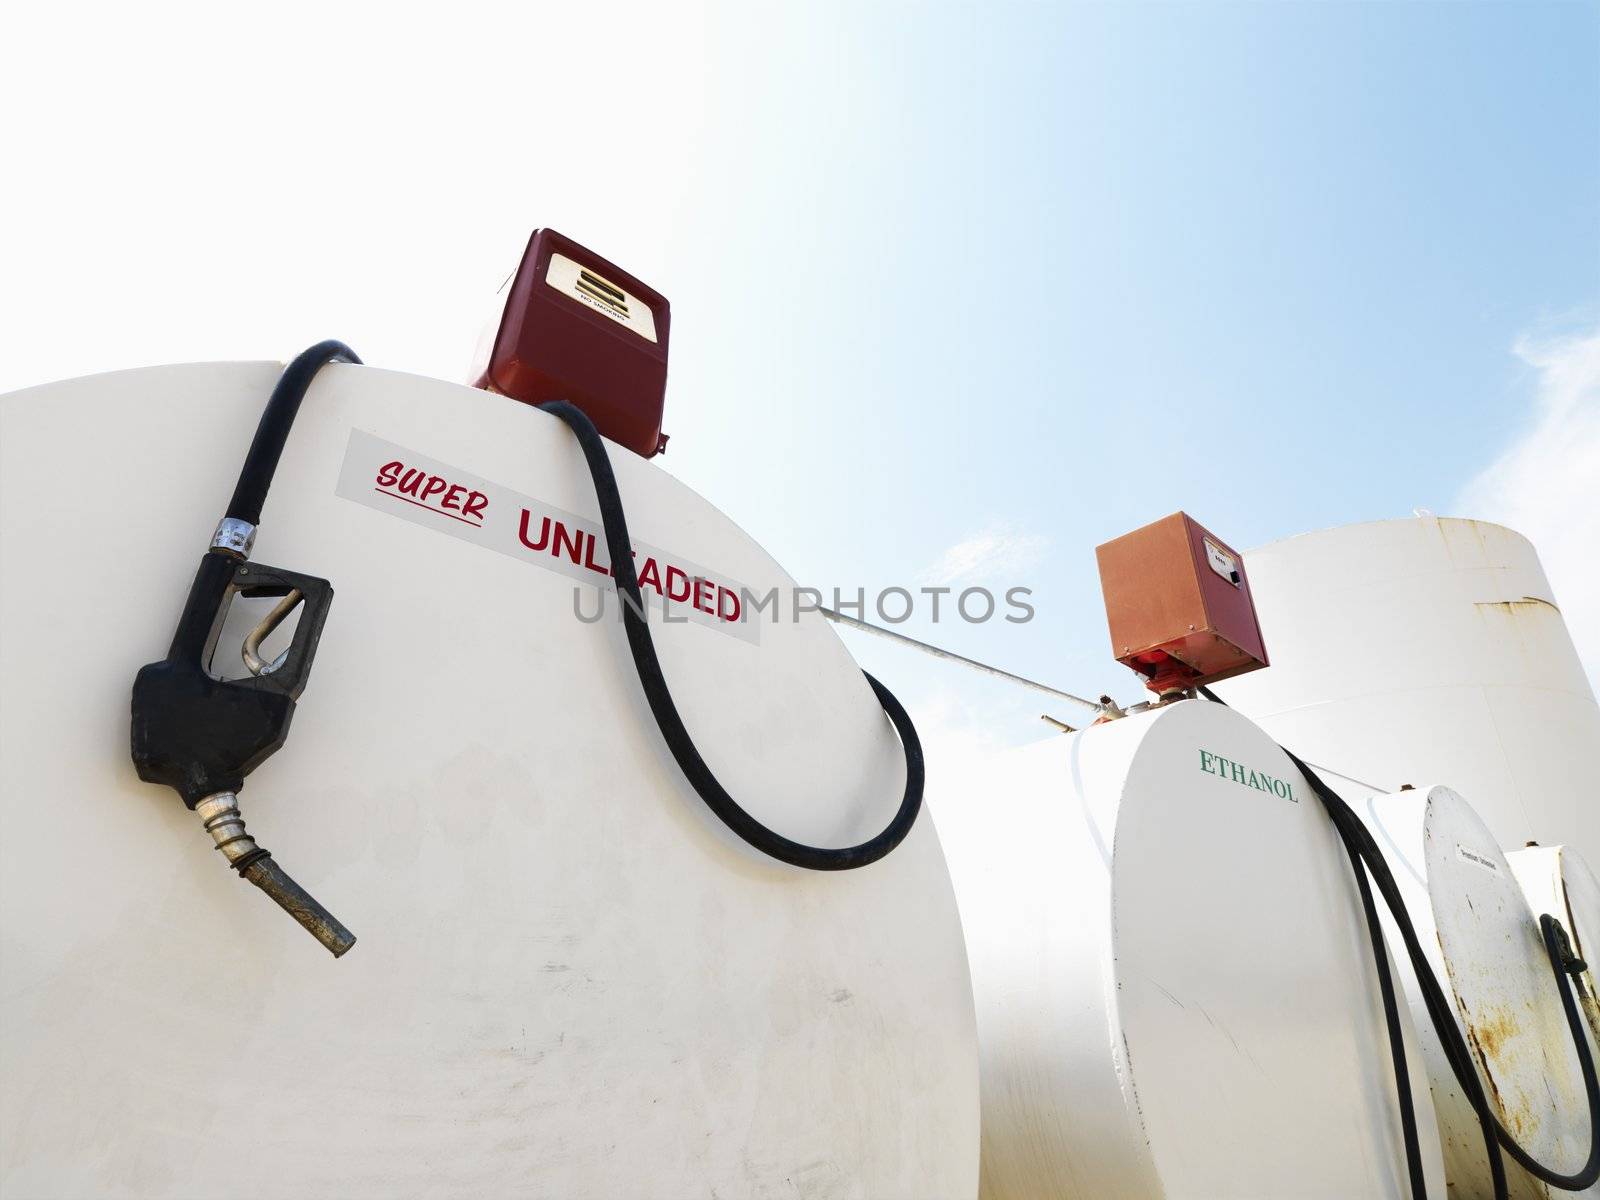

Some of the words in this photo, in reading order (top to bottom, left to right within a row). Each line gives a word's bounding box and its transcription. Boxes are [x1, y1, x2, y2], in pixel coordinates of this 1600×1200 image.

[580, 294, 592, 303] NO
[593, 301, 625, 321] SMOKING
[375, 461, 489, 521] SUPER
[519, 509, 741, 622] UNLADED
[1199, 749, 1299, 803] ETHANOL
